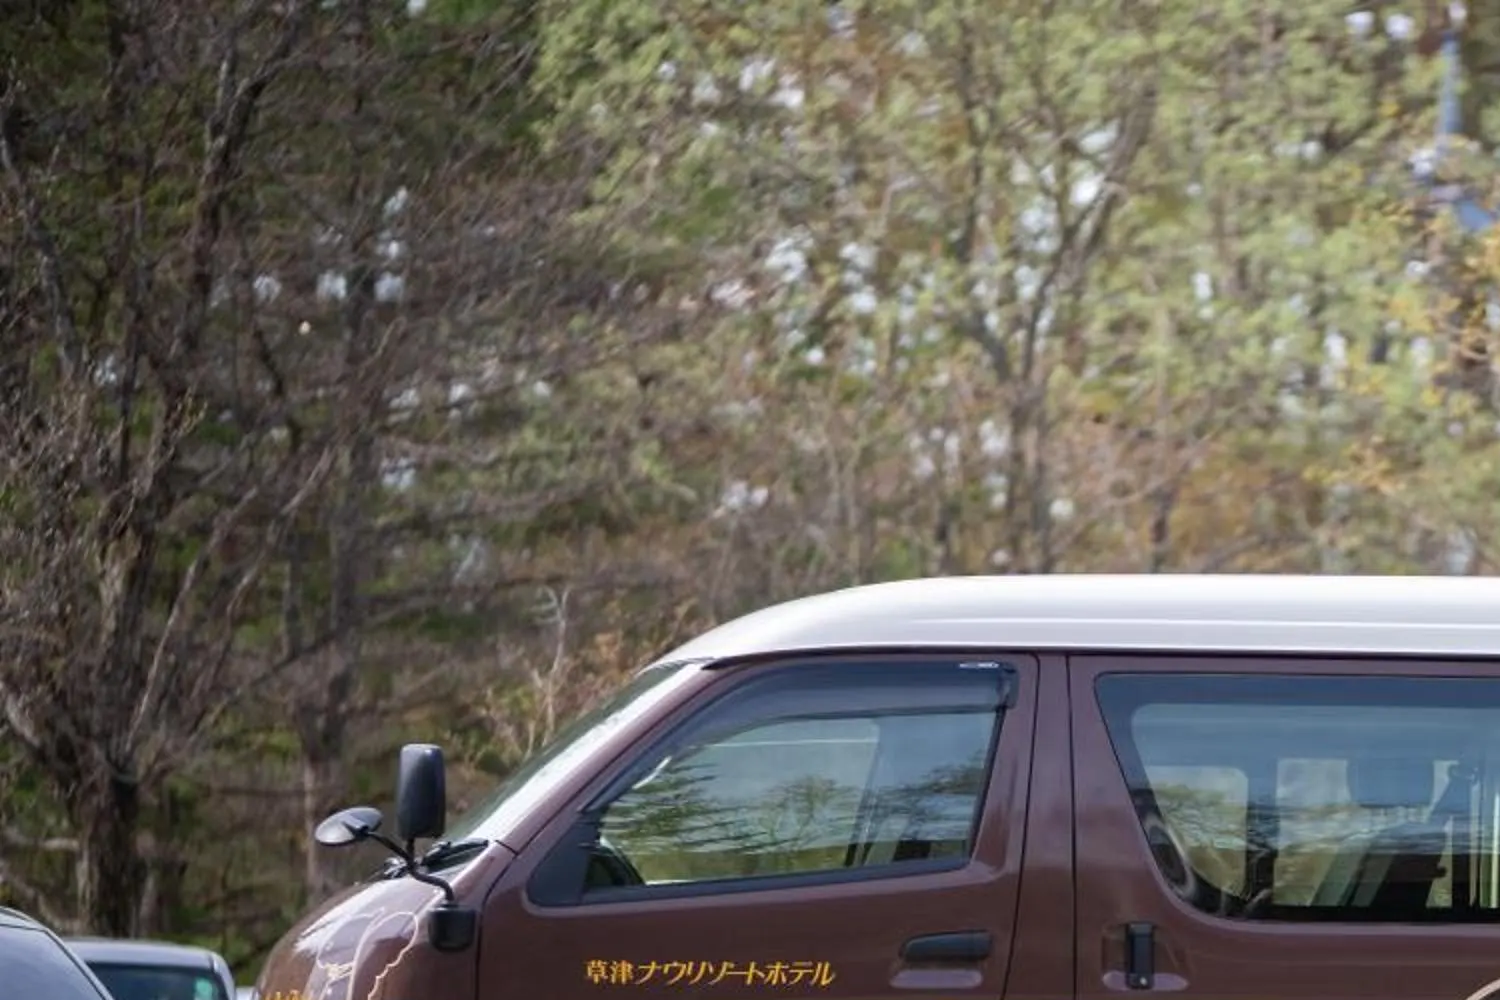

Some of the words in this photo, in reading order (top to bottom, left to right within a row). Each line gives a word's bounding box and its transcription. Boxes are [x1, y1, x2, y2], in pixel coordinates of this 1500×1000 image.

[586, 960, 835, 985] 草津ナウリゾートホテル
